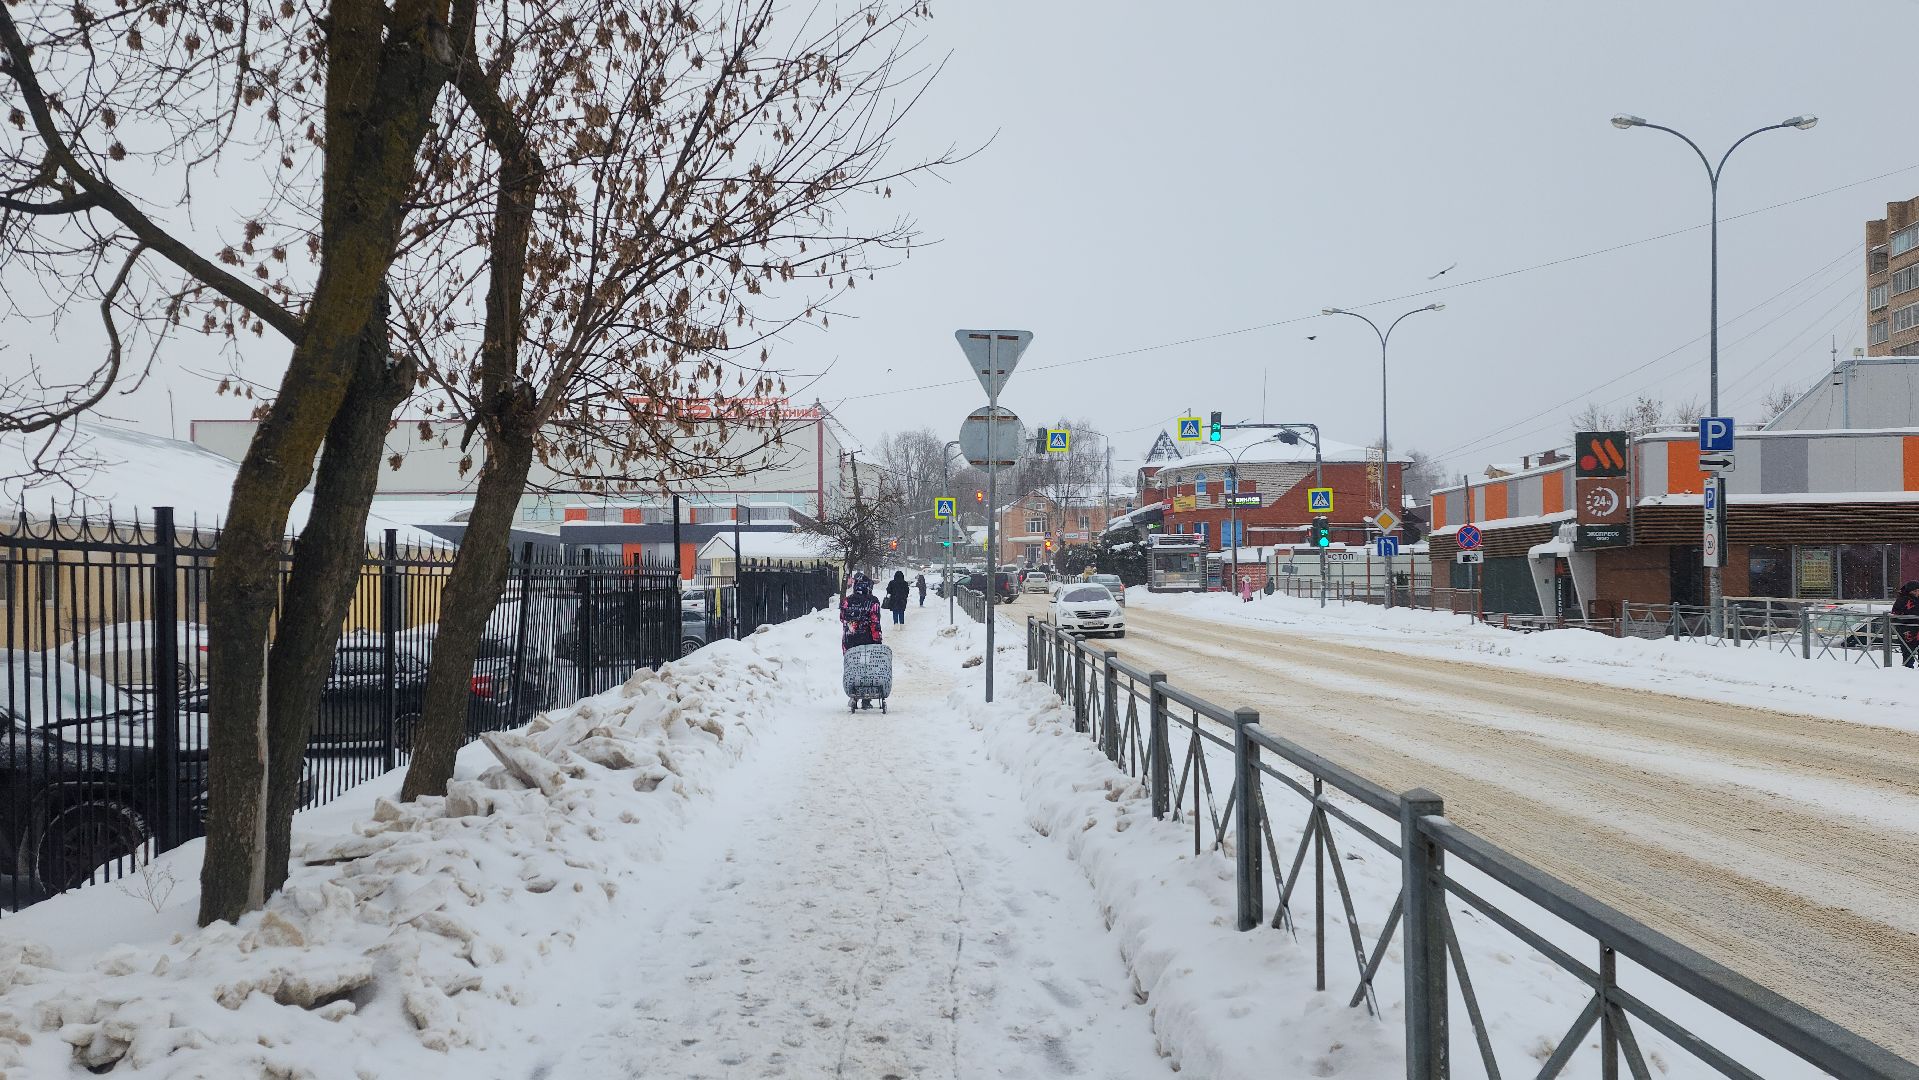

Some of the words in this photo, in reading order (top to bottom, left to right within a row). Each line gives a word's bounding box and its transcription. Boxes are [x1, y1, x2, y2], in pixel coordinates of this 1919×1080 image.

[1707, 420, 1727, 447] P
[1707, 489, 1714, 508] P
[1331, 553, 1354, 561] СТОП
